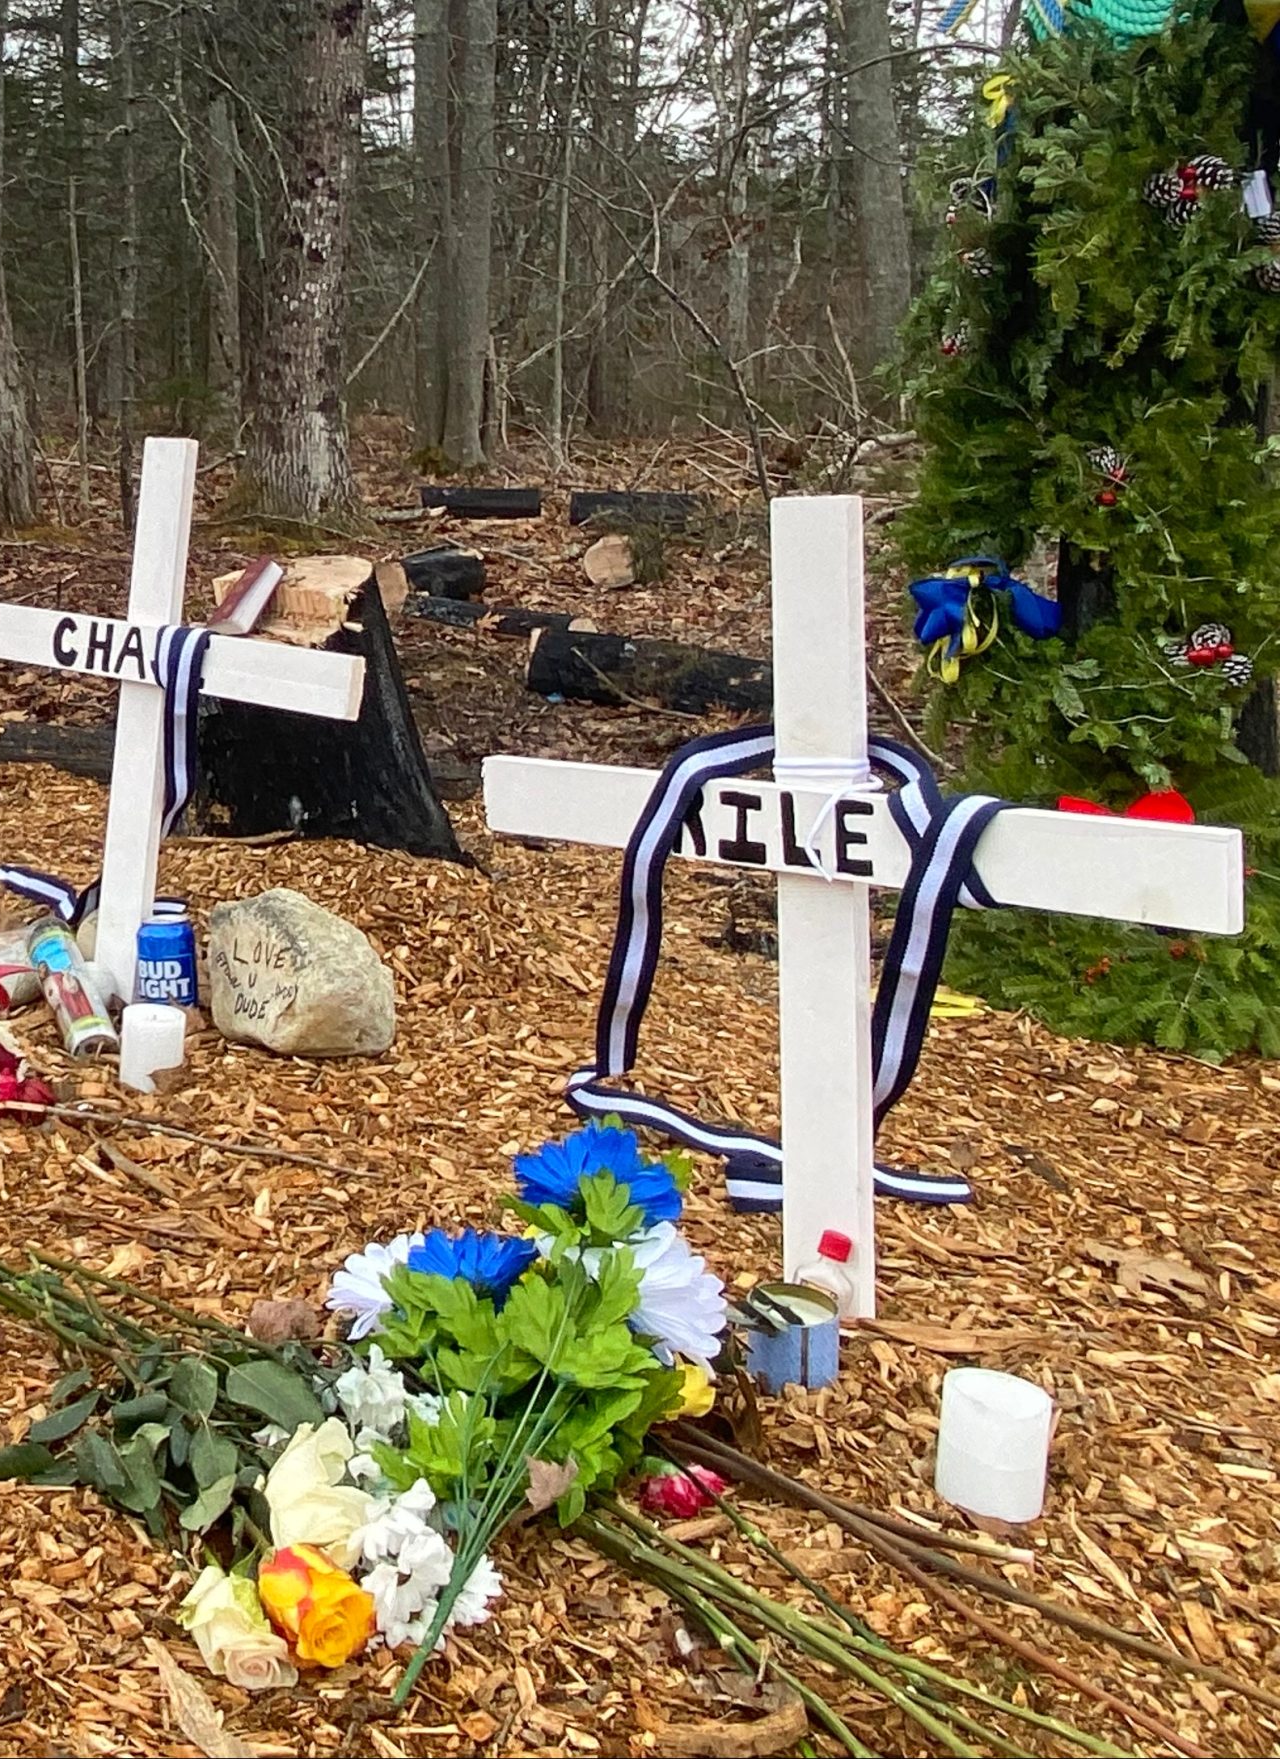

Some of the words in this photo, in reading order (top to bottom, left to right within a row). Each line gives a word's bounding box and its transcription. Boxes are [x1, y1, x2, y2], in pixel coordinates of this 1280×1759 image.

[53, 616, 146, 680] CHA
[672, 786, 874, 877] RILE
[233, 937, 293, 969] LOVE
[138, 960, 182, 980] BUD
[247, 973, 258, 989] U
[138, 977, 191, 999] IGHT
[234, 992, 270, 1020] DUDE
